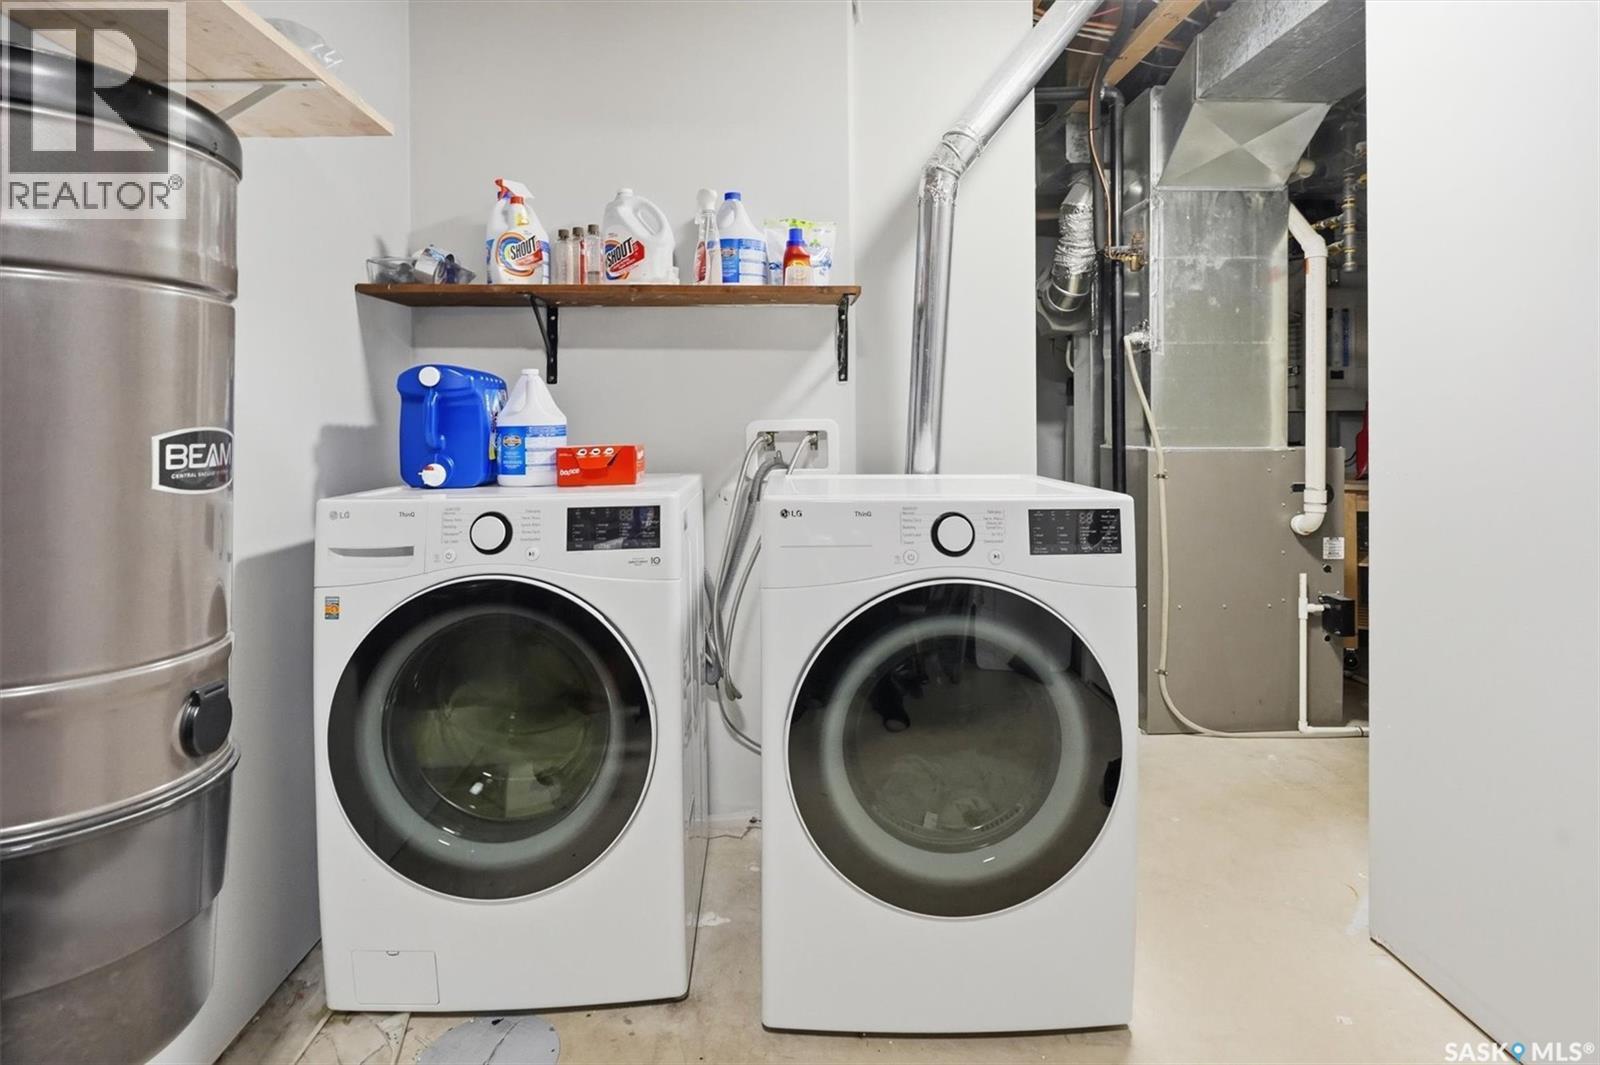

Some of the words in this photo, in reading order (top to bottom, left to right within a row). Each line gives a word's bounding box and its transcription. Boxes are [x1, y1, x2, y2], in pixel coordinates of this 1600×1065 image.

[510, 234, 536, 260] SHOUT
[606, 236, 632, 268] SHOUT
[165, 442, 231, 470] BEAM
[339, 511, 350, 519] LG
[791, 509, 803, 518] LG
[854, 510, 872, 518] ThinQ
